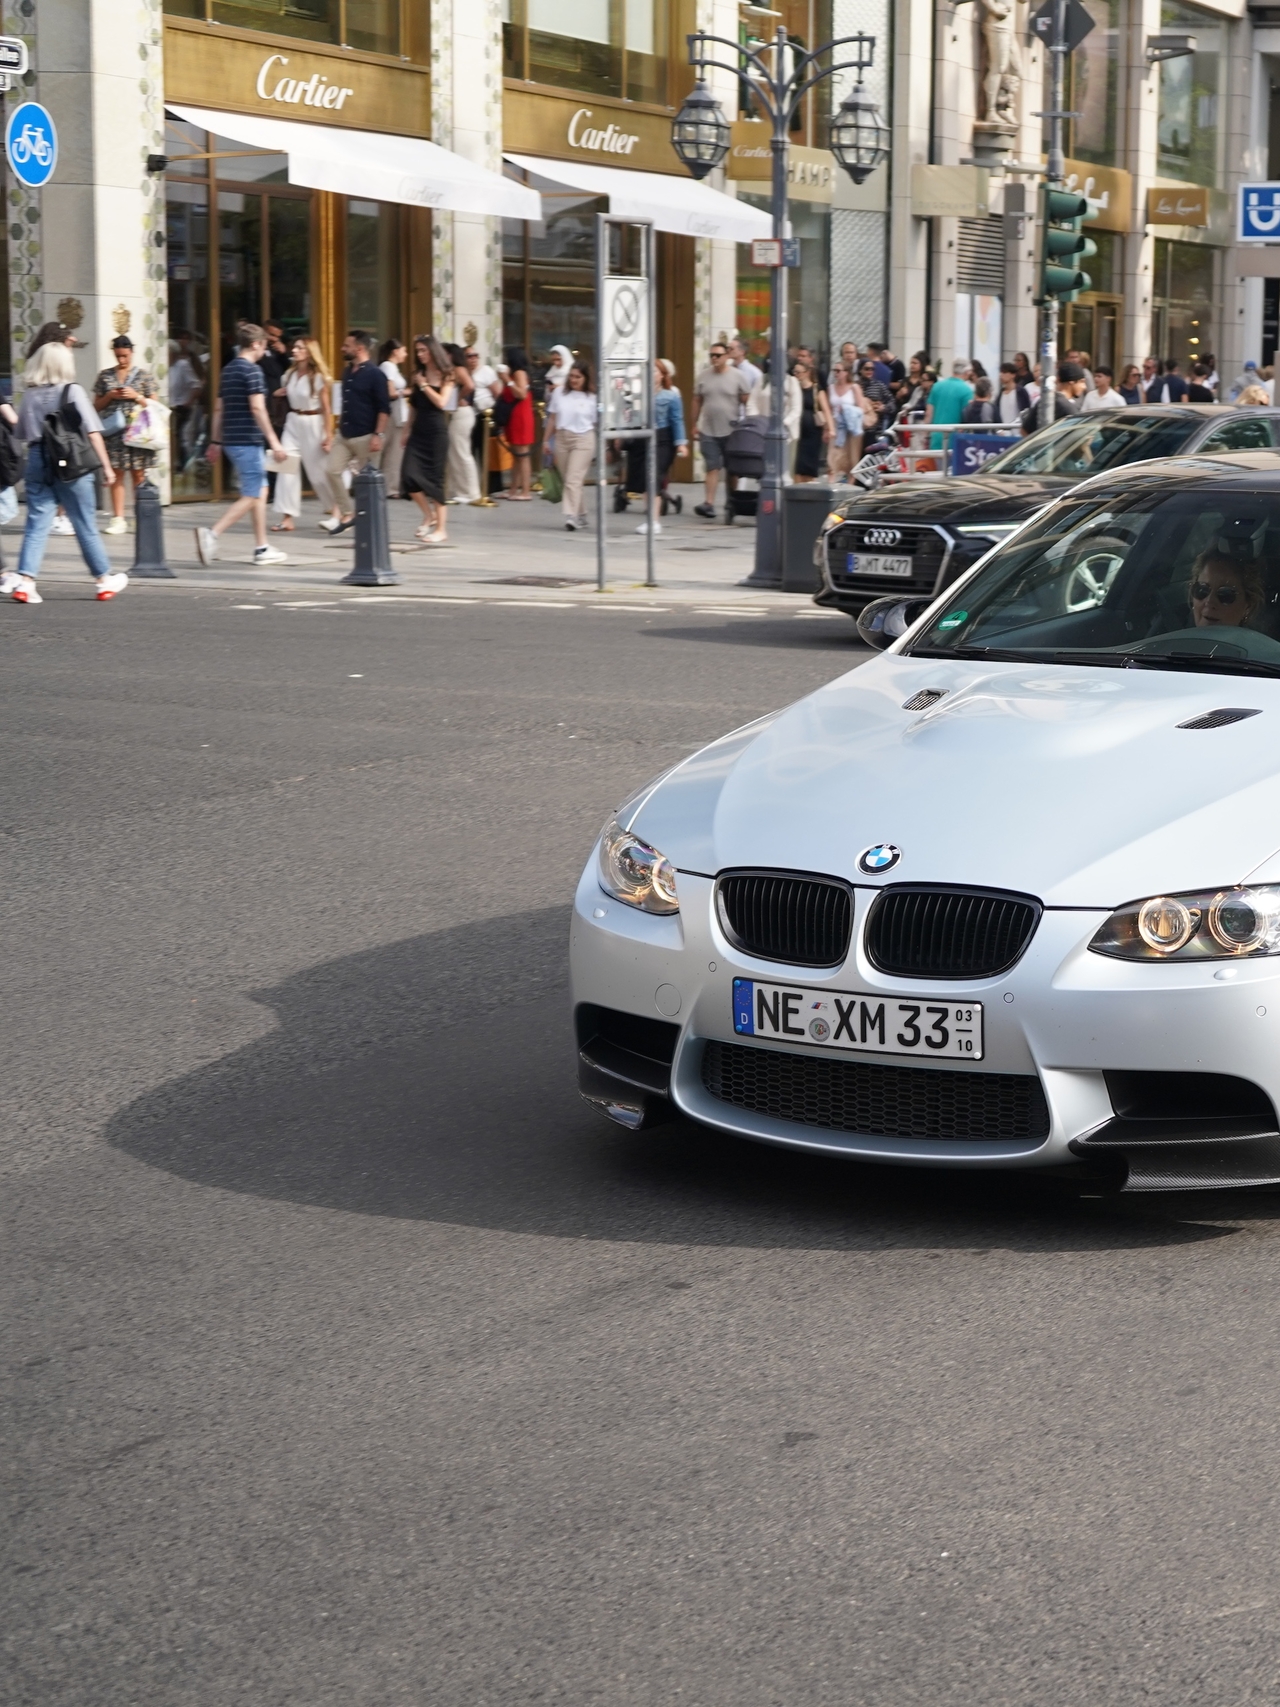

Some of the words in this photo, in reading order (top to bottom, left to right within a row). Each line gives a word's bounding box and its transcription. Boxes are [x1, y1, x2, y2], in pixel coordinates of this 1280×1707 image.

[257, 54, 354, 110] Cartier
[567, 108, 640, 155] Cartier
[732, 145, 774, 158] Cartie
[964, 446, 1005, 467] Ste
[882, 558, 909, 574] 4477
[740, 1012, 749, 1025] D
[756, 988, 806, 1036] NE
[833, 998, 886, 1045] XM
[896, 1004, 949, 1049] 33
[955, 1009, 973, 1022] 03
[957, 1038, 973, 1052] 10
